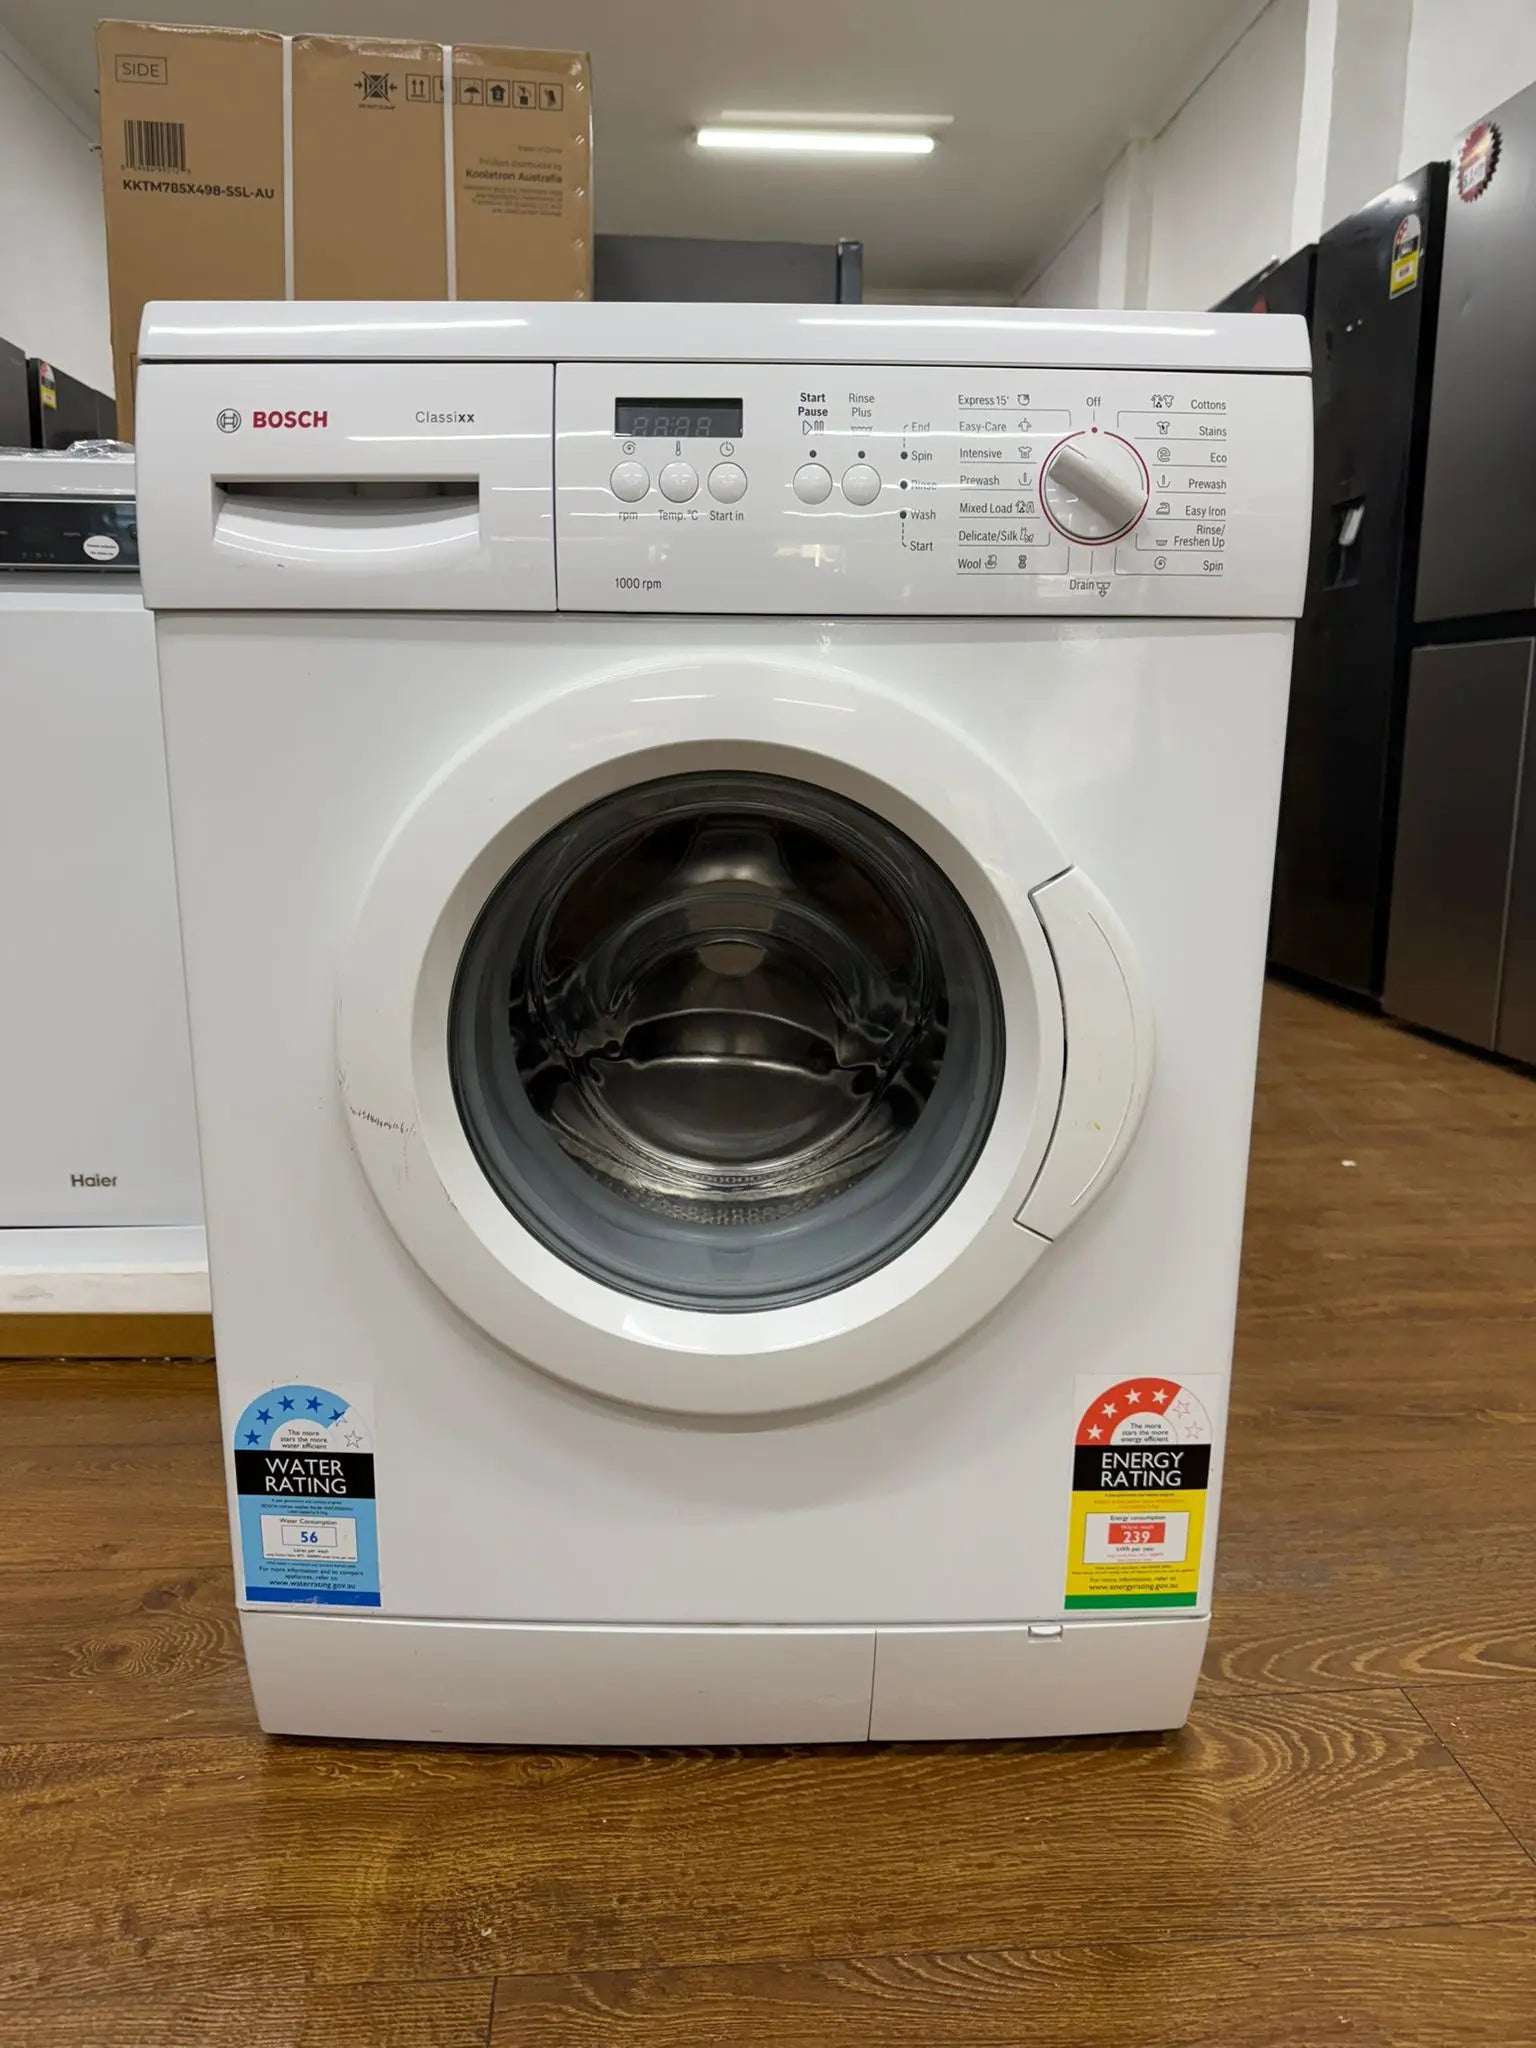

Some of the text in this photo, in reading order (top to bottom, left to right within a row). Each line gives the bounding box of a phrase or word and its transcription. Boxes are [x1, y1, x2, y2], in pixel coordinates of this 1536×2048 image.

[122, 63, 160, 78] SIDE
[466, 168, 562, 183] Koolatron Australia
[800, 392, 826, 403] Start
[848, 393, 875, 404] Rinse
[958, 394, 995, 406] Express
[1086, 397, 1101, 408] Off
[1190, 399, 1226, 410] Cottons
[798, 406, 828, 416] Pause
[852, 408, 872, 418] Plus
[253, 410, 328, 428] BOSCH
[415, 410, 474, 424] Classixx
[912, 422, 930, 432] End
[959, 422, 1006, 433] Easy-Care
[1199, 426, 1227, 436] Stains
[912, 451, 932, 462] Spin
[960, 448, 1002, 458] Intensive
[1210, 452, 1227, 463] Eco
[960, 475, 1000, 486] Prewash
[1188, 478, 1226, 489] Prewash
[960, 502, 1012, 514] Mixed Load
[1185, 506, 1226, 518] Easy Iron
[618, 511, 638, 520] rpm
[709, 510, 744, 520] Start in
[911, 509, 936, 520] Wash
[1196, 524, 1226, 536] Rinse/
[958, 530, 1018, 542] Delicate/Silk
[910, 541, 934, 552] Start
[1174, 536, 1225, 548] Freshen Up
[958, 558, 982, 569] Wool
[1202, 560, 1224, 572] Spin
[616, 578, 662, 590] 1000 rpm
[1070, 579, 1094, 590] Drain
[70, 1174, 118, 1187] Haier
[302, 1442, 327, 1450] efficient
[1102, 1452, 1184, 1469] ENERGY
[266, 1458, 344, 1476] WATER
[1100, 1470, 1182, 1488] RATING
[265, 1476, 346, 1494] RATING
[300, 1531, 318, 1543] 56
[1123, 1530, 1150, 1543] 239
[270, 1580, 356, 1590] www.waterrating.gov.au
[1088, 1582, 1178, 1591] www.energyrating.gov.au
